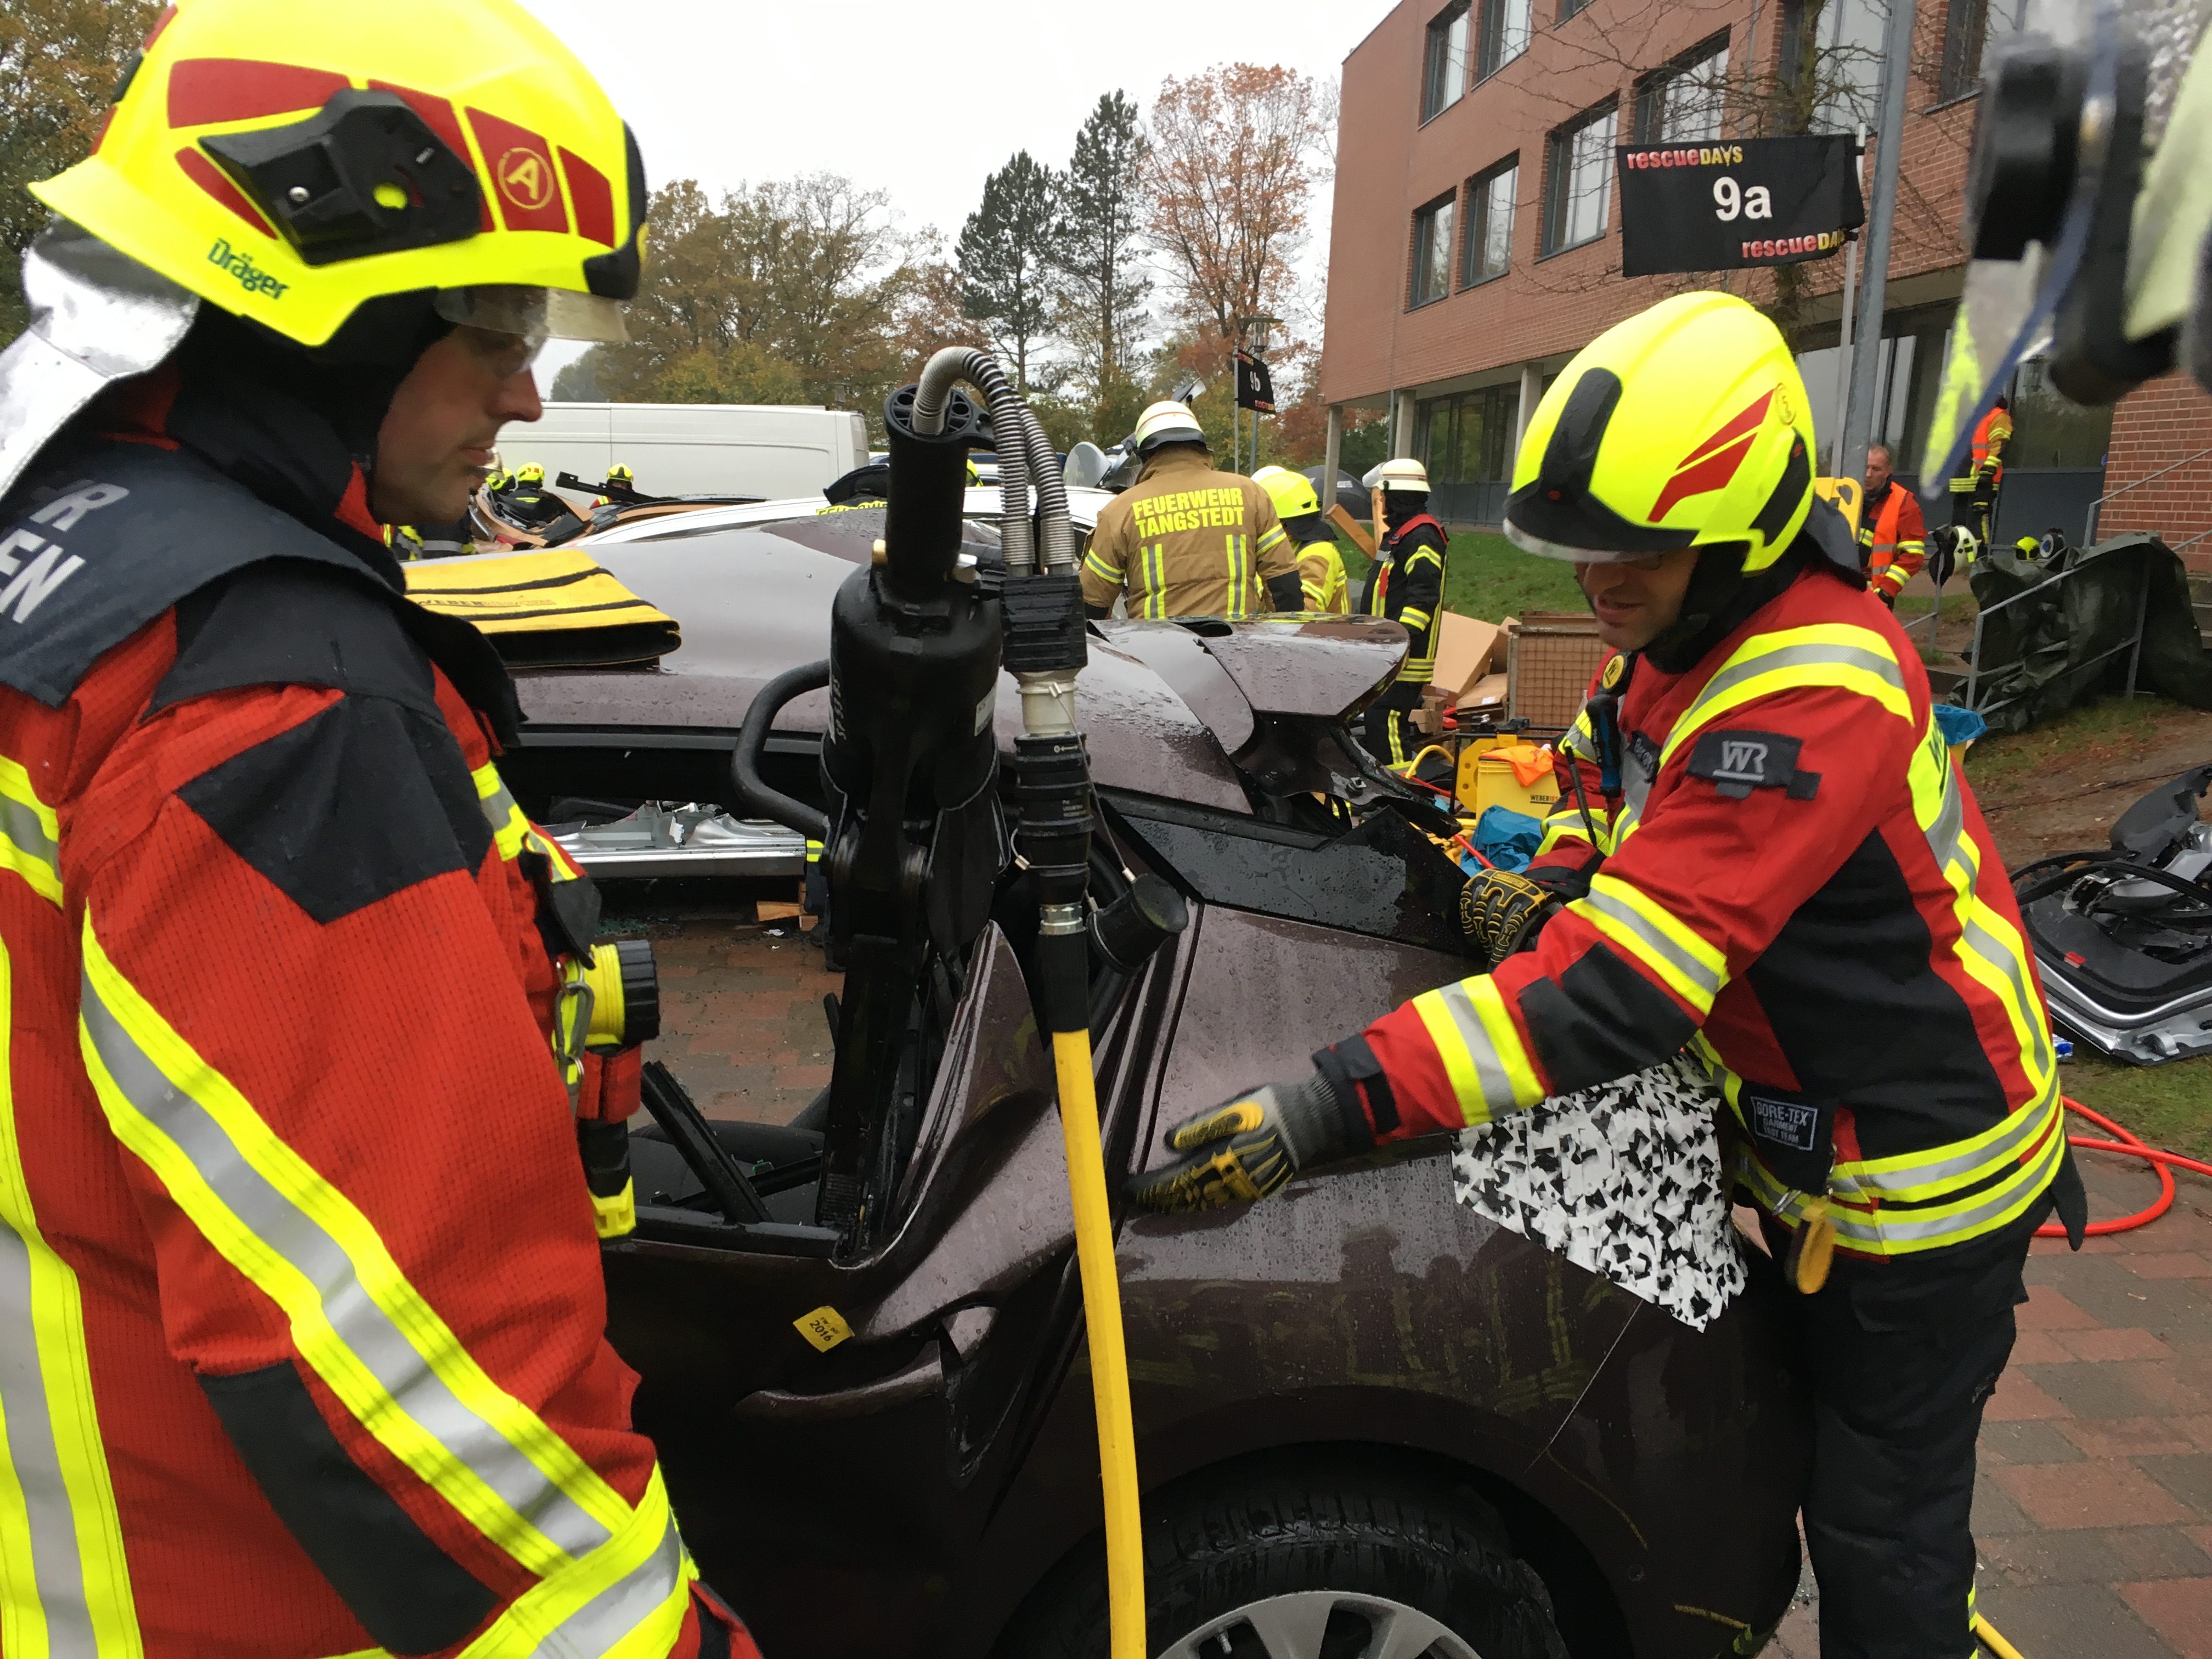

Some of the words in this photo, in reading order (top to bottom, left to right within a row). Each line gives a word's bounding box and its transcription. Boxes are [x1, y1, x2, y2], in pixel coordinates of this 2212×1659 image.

[1627, 144, 1743, 170] rescueDAYS
[505, 157, 538, 200] A
[1713, 176, 1773, 221] 9a
[1742, 228, 1846, 258] rescueDA
[207, 238, 290, 300] Dräger
[1132, 488, 1244, 520] FEUERWEHR
[1135, 507, 1244, 539] TANGSTEDT
[1722, 741, 1768, 774] WR
[1757, 1101, 1809, 1126] GORE-TEX
[809, 1319, 834, 1341] 2016
